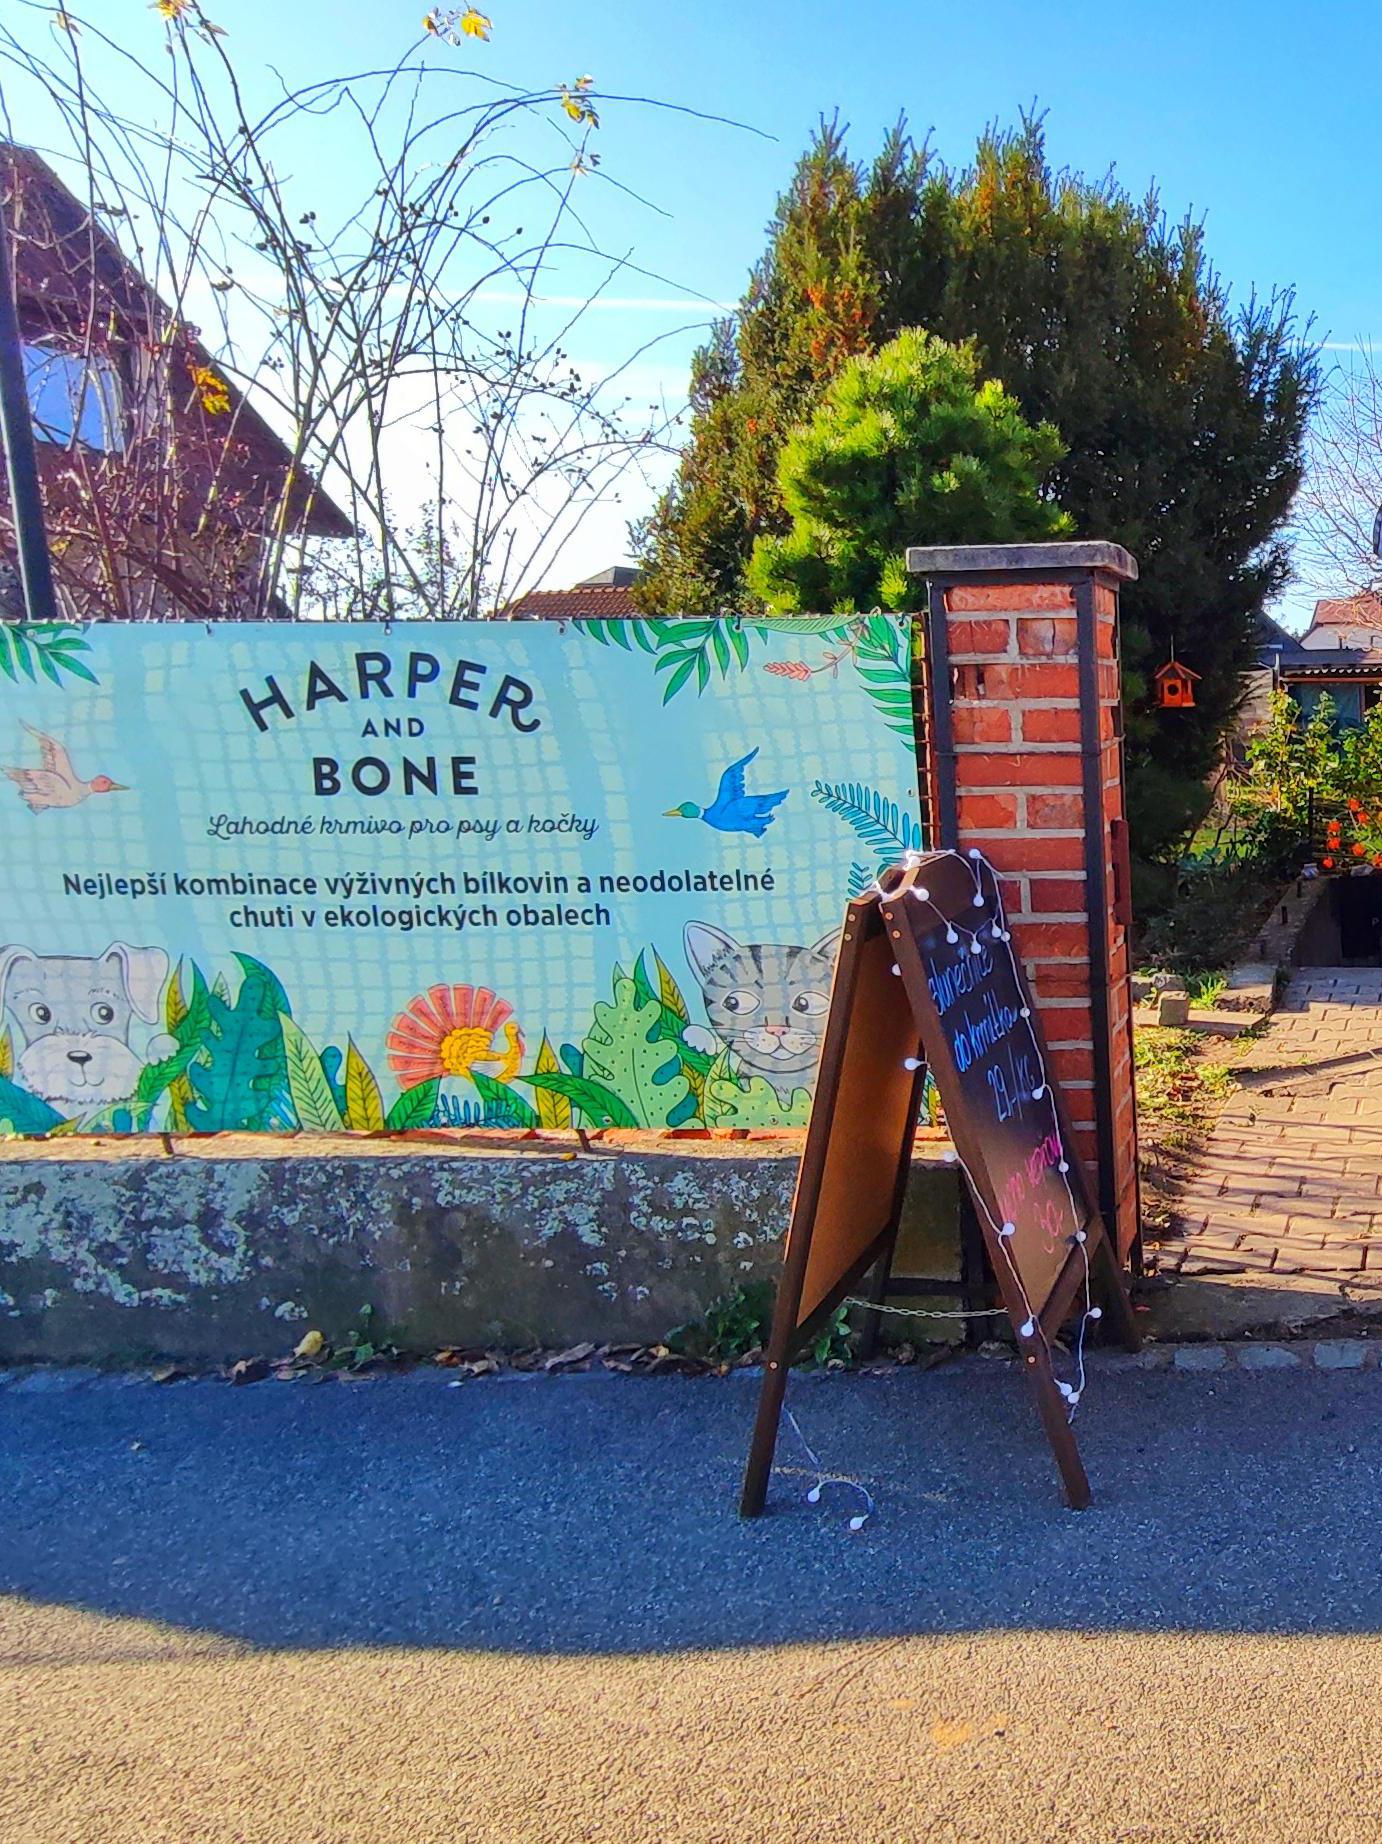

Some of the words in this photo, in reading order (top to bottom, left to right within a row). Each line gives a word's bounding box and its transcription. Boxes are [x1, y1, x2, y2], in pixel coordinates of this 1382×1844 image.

[239, 652, 541, 732] HARPER
[361, 717, 425, 737] AND
[313, 756, 479, 796] BONE
[207, 814, 315, 840] Lahodné
[319, 815, 405, 835] krmivo
[408, 818, 453, 839] pro
[456, 819, 500, 841] psy
[506, 818, 524, 833] a
[527, 813, 600, 840] kočky
[62, 872, 168, 900] Nejlepší
[174, 872, 318, 895] kombinace
[324, 870, 456, 899] výživných
[463, 870, 569, 895] bílkovin
[577, 876, 592, 892] a
[600, 868, 775, 893] neodolatelné
[229, 904, 293, 928] chuti
[301, 909, 316, 928] v
[324, 903, 498, 932] ekologických
[506, 903, 611, 927] obalech
